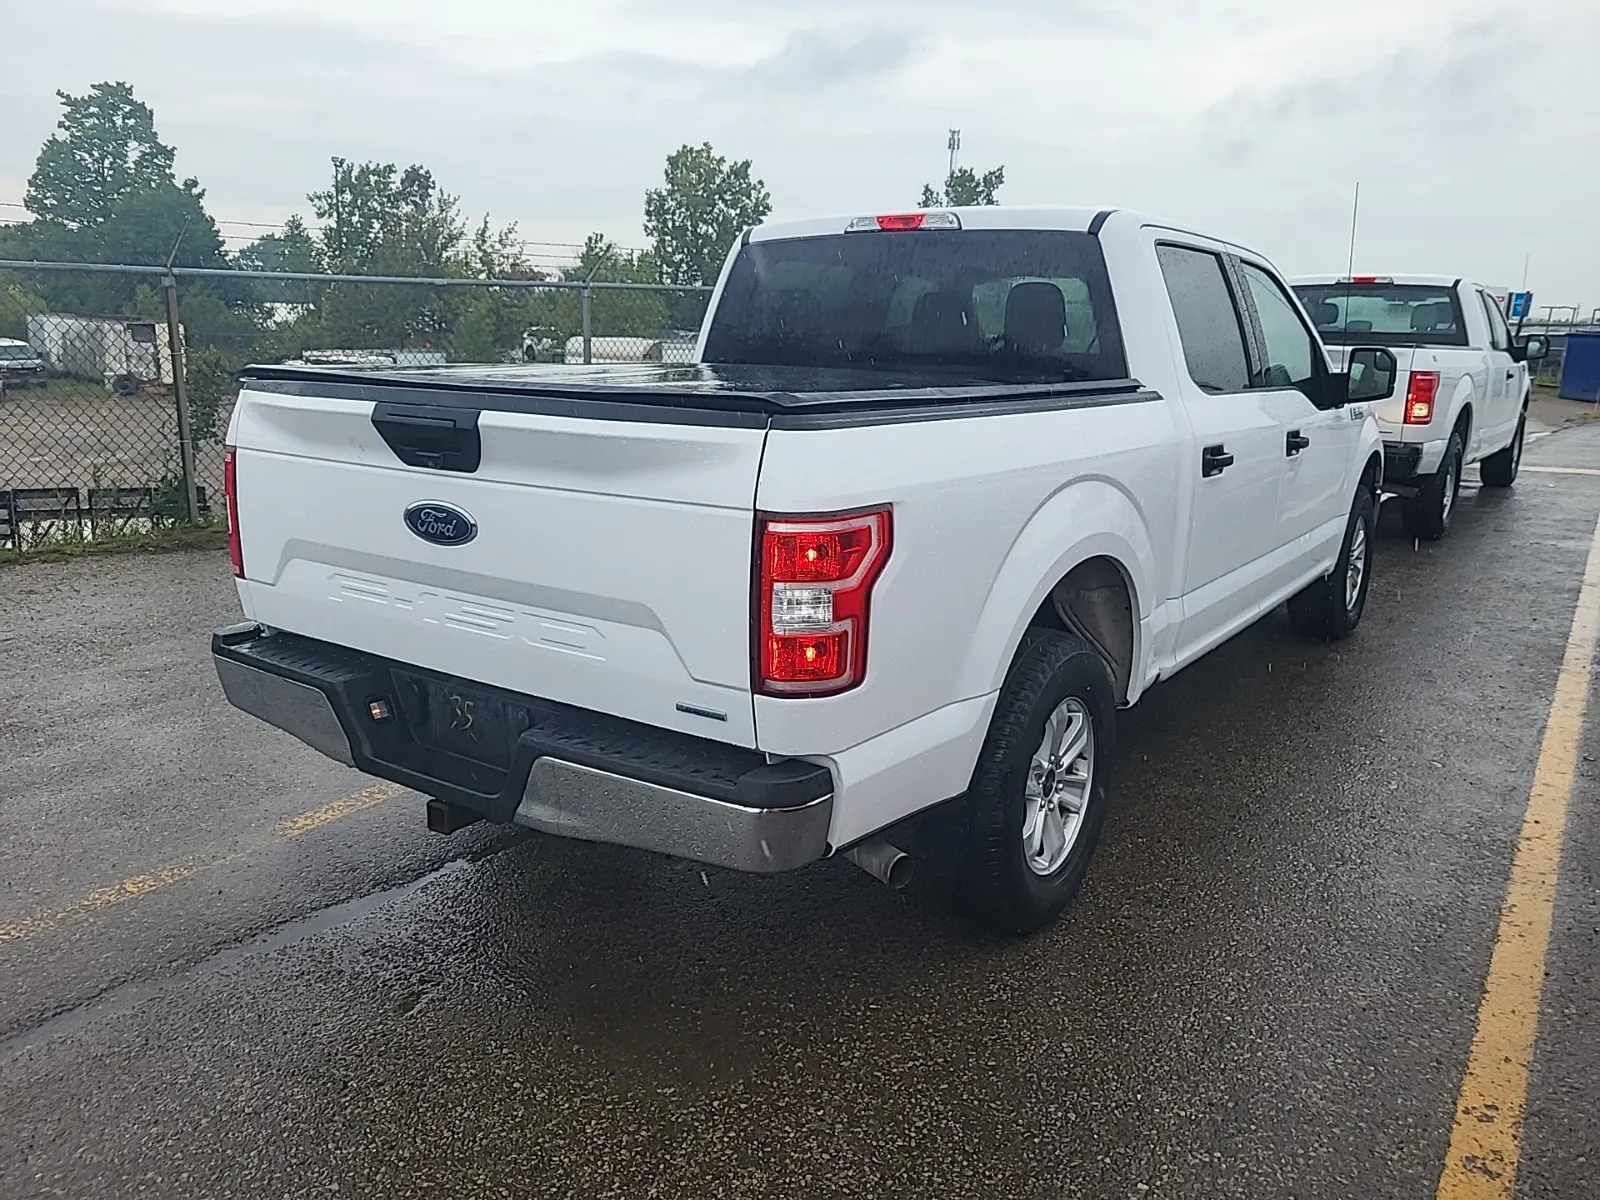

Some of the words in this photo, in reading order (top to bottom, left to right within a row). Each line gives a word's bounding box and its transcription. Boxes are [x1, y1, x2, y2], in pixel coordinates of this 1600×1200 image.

[417, 509, 457, 537] Ford
[327, 573, 606, 661] F-150
[450, 694, 475, 731] 35
